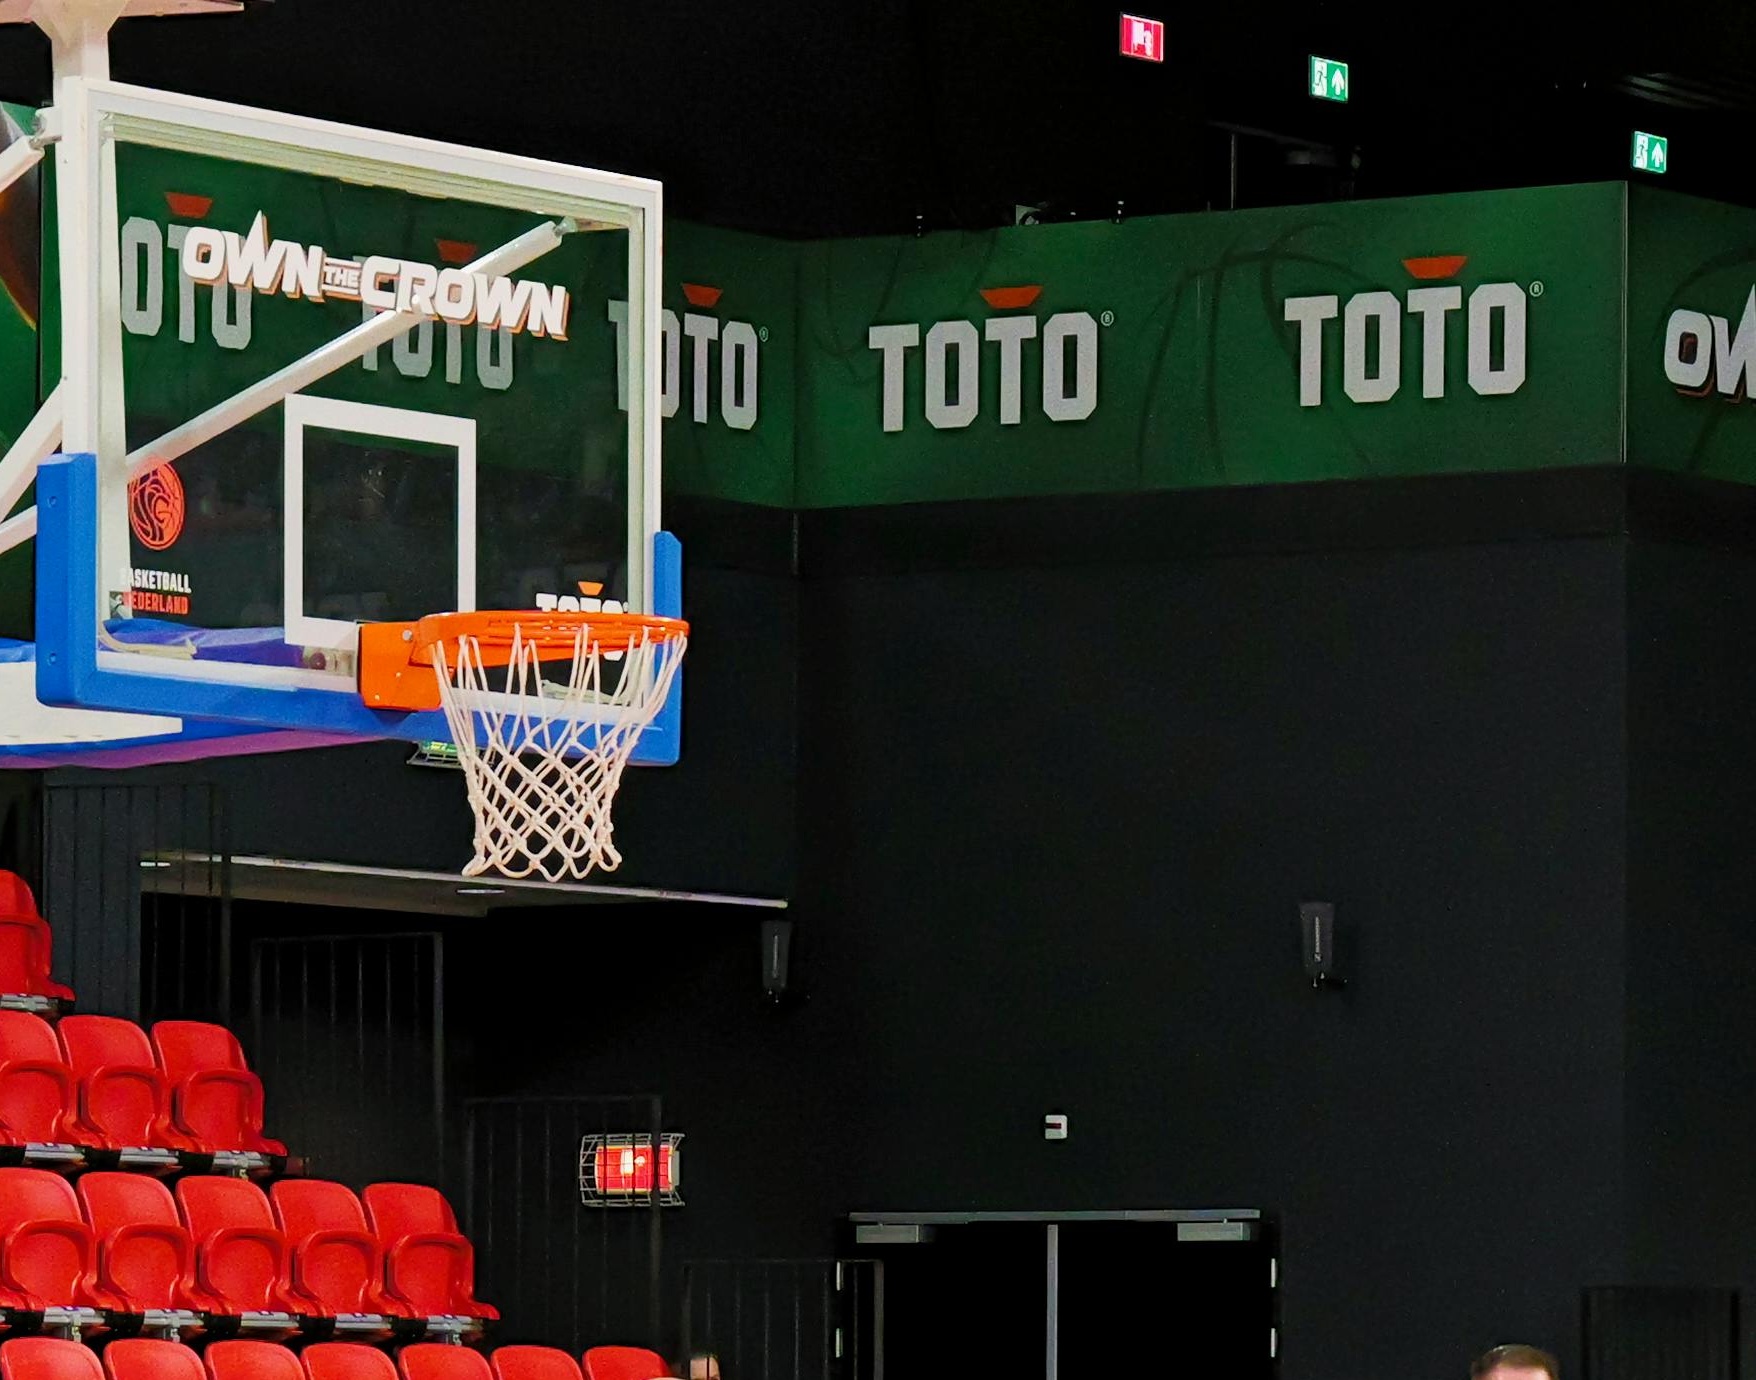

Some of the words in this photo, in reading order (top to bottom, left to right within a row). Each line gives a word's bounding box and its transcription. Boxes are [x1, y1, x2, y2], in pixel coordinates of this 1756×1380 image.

[182, 210, 324, 301] OWN
[323, 266, 362, 290] THE
[360, 255, 569, 339] CROWN
